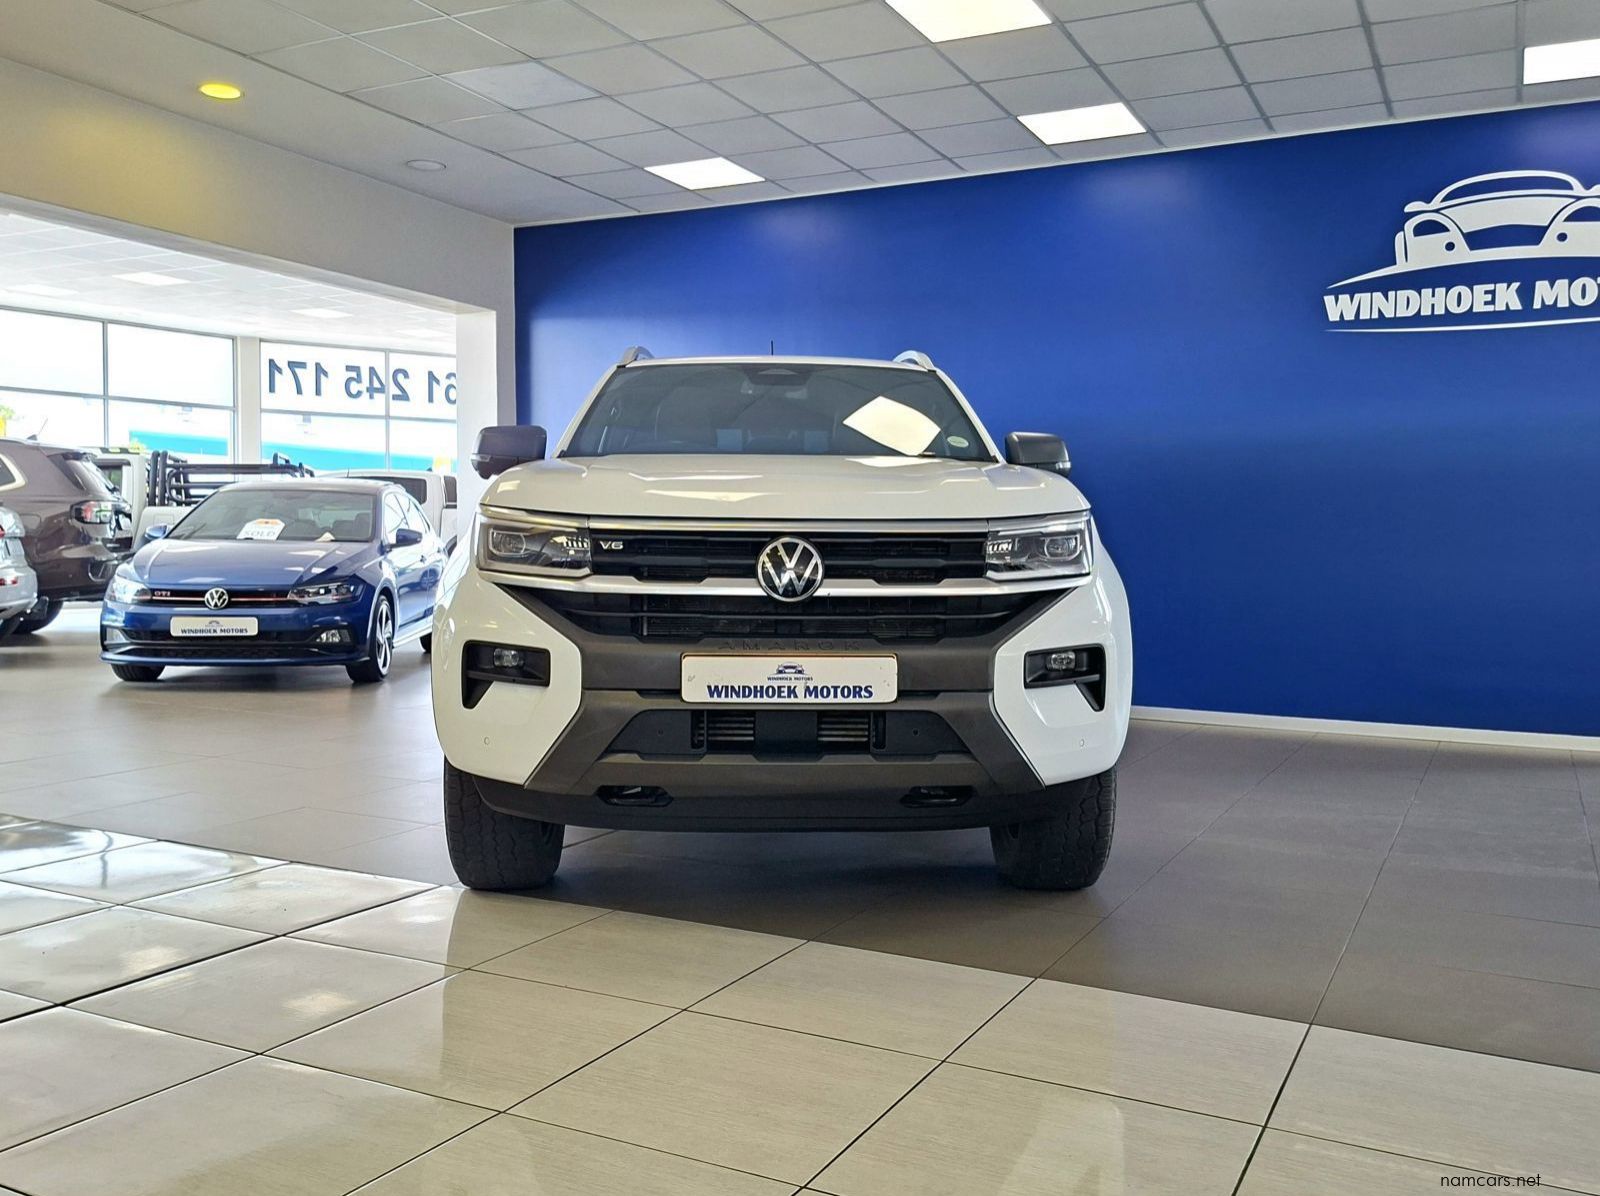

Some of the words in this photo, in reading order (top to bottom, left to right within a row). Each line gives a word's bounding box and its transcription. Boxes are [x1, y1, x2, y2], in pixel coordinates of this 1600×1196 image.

[1323, 281, 1523, 322] WINDHOEK
[1533, 276, 1600, 310] MO
[600, 541, 624, 550] V6
[717, 641, 861, 650] AMAROK
[707, 685, 799, 699] WINDHOEK
[804, 685, 874, 699] MOTORS
